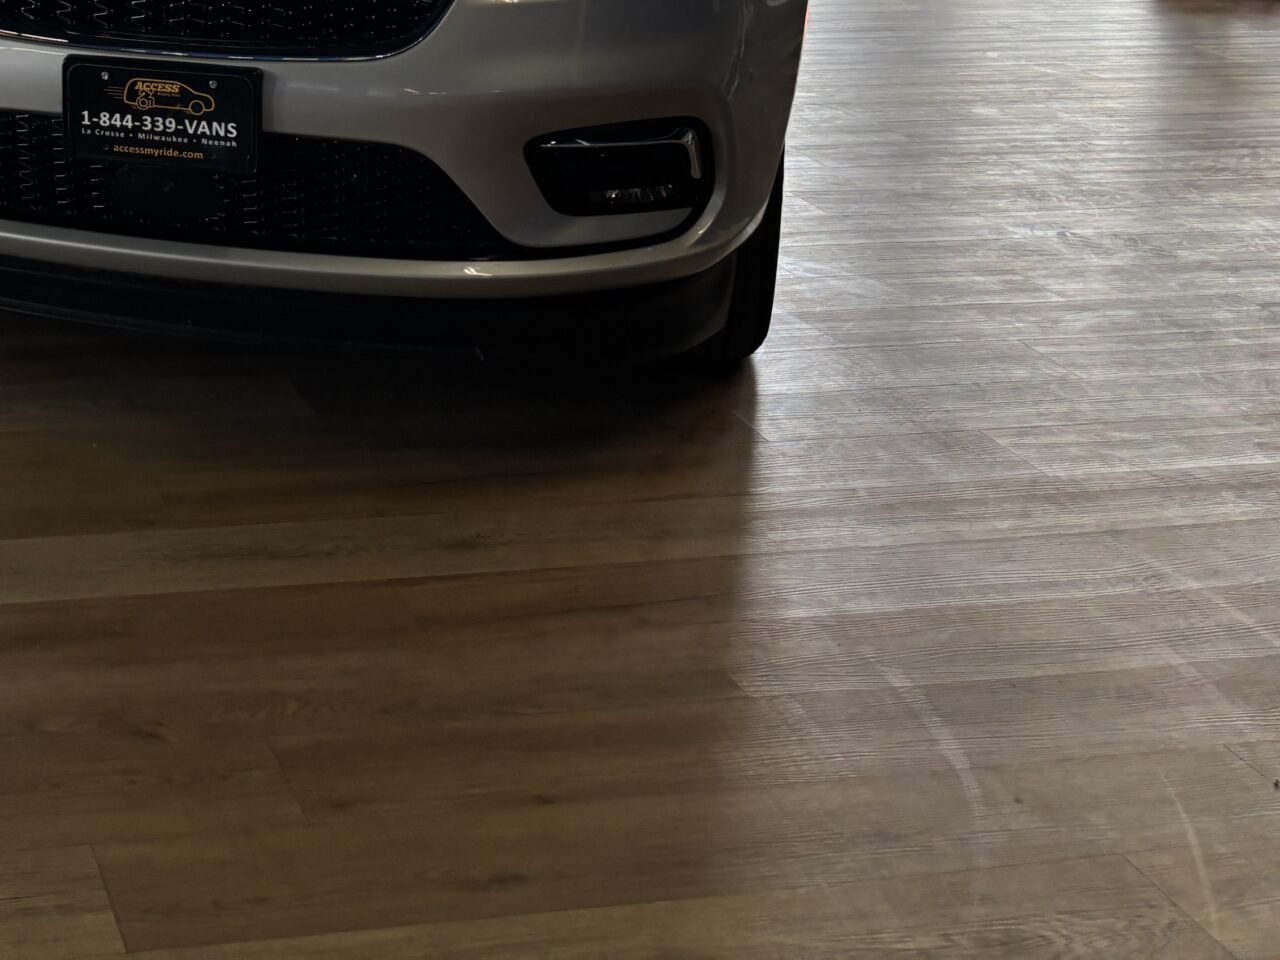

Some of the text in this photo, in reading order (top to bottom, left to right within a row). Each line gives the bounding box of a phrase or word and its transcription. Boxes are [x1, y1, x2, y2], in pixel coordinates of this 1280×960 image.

[135, 81, 180, 94] ACCESS
[81, 110, 238, 138] 1-844-339-VANS
[81, 127, 237, 148] La Crosse Milwaukee Neenah
[113, 144, 204, 159] accessmyride.com
